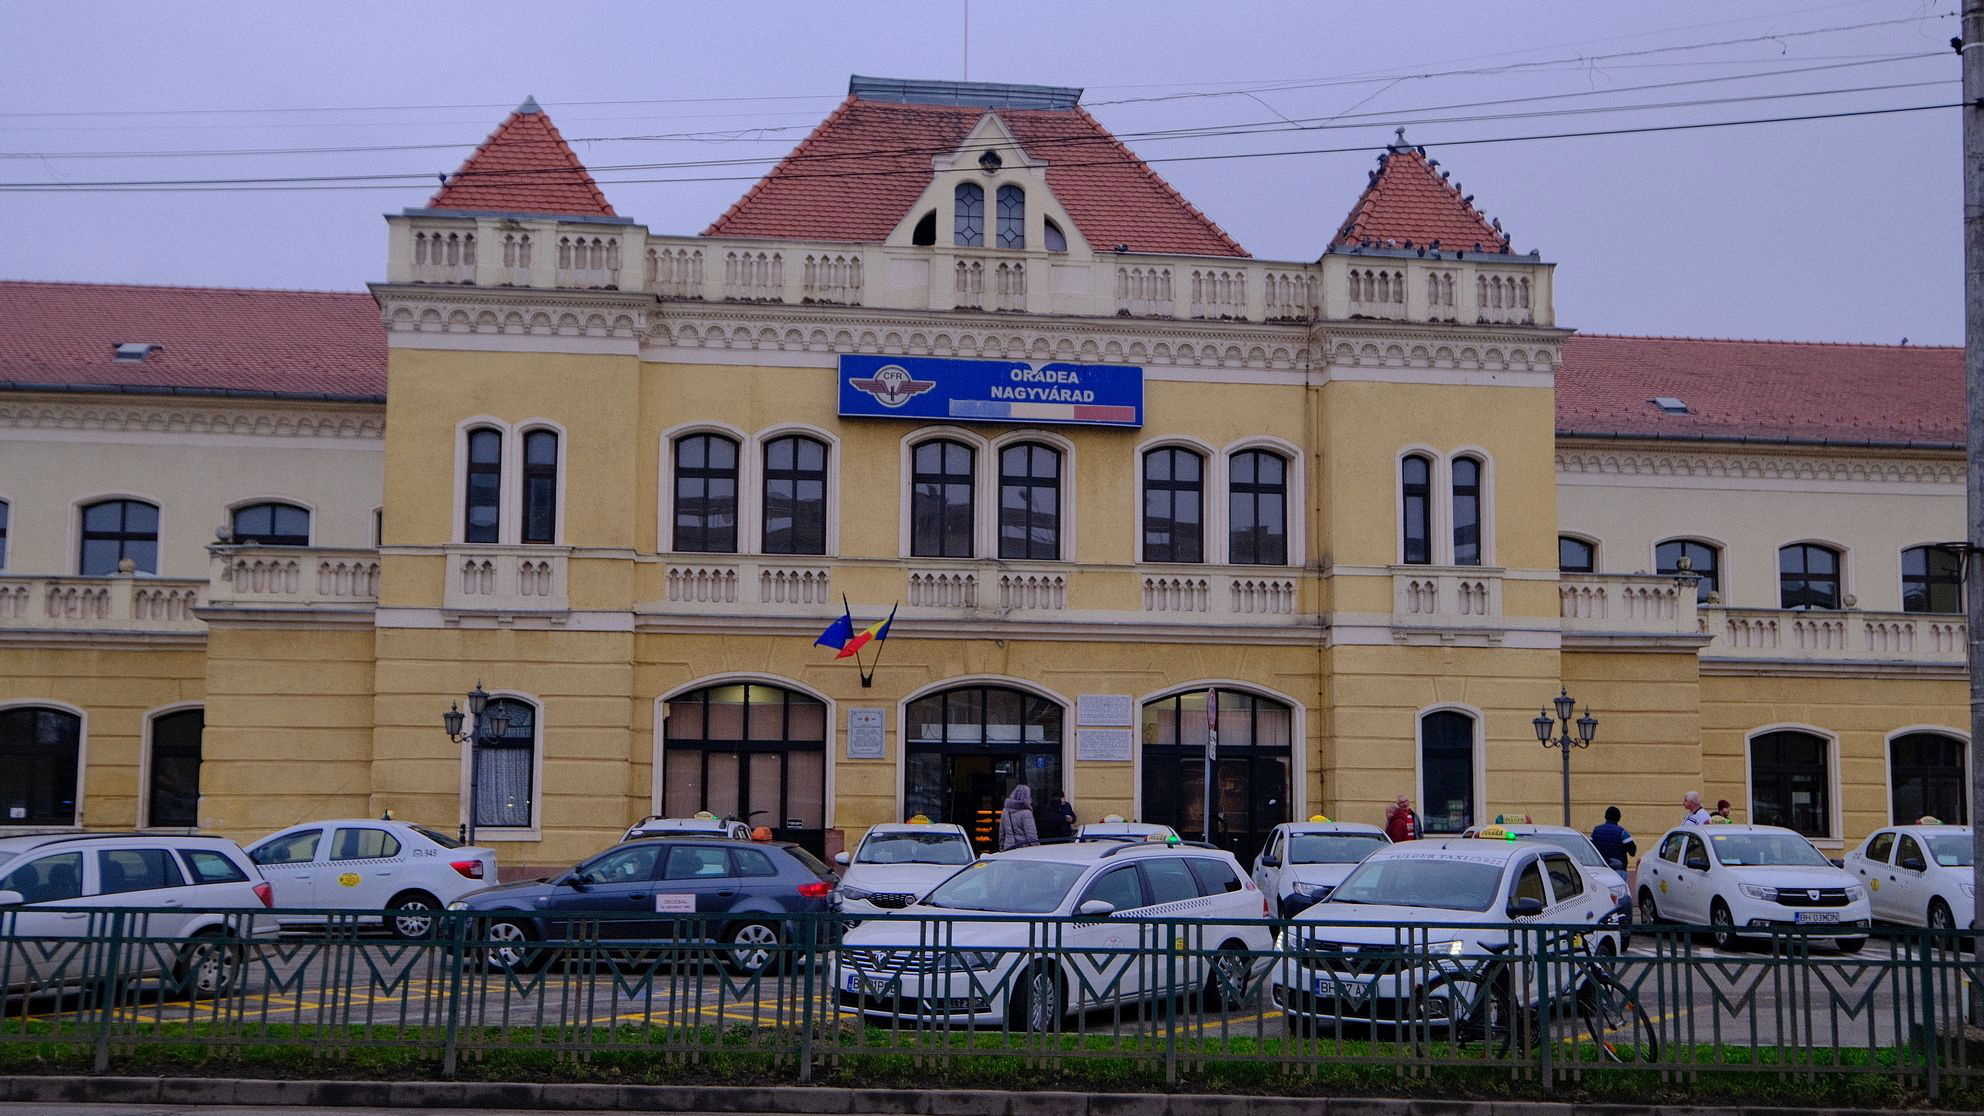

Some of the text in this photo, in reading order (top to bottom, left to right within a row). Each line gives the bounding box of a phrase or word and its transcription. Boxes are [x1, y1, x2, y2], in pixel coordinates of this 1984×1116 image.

[883, 372, 903, 380] CFR
[1010, 369, 1079, 384] ORADEA
[990, 384, 1095, 402] NAGYVÁRAD
[424, 849, 437, 857] 945
